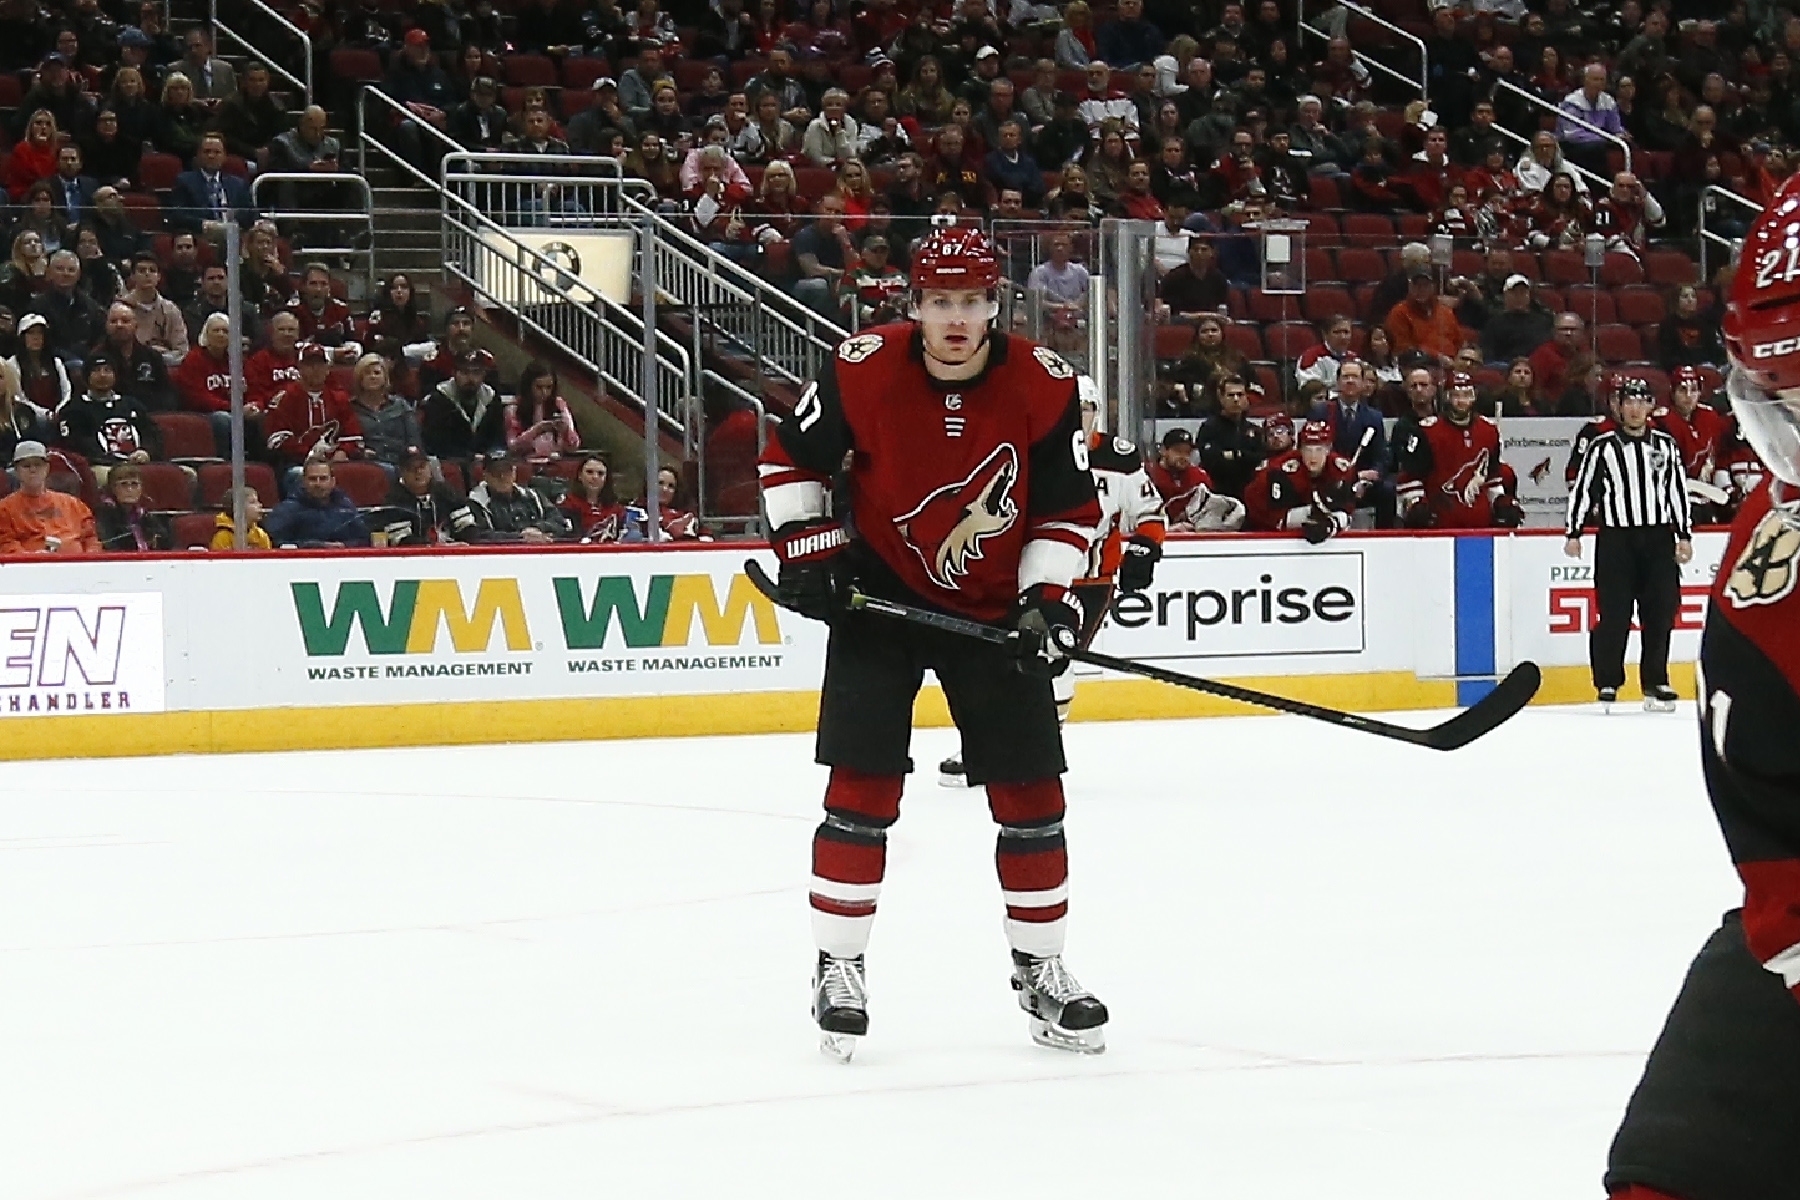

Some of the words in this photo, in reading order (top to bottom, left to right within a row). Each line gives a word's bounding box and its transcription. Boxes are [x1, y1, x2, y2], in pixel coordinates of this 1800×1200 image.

[941, 243, 963, 256] 67
[1550, 566, 1595, 581] PIZZ
[1104, 573, 1356, 642] erprise
[307, 666, 380, 681] WASTE
[386, 661, 534, 679] MANAGEMENT
[567, 659, 637, 674] WASTE
[642, 654, 784, 671] MANAGEMENT
[0, 691, 131, 712] HANDLER
